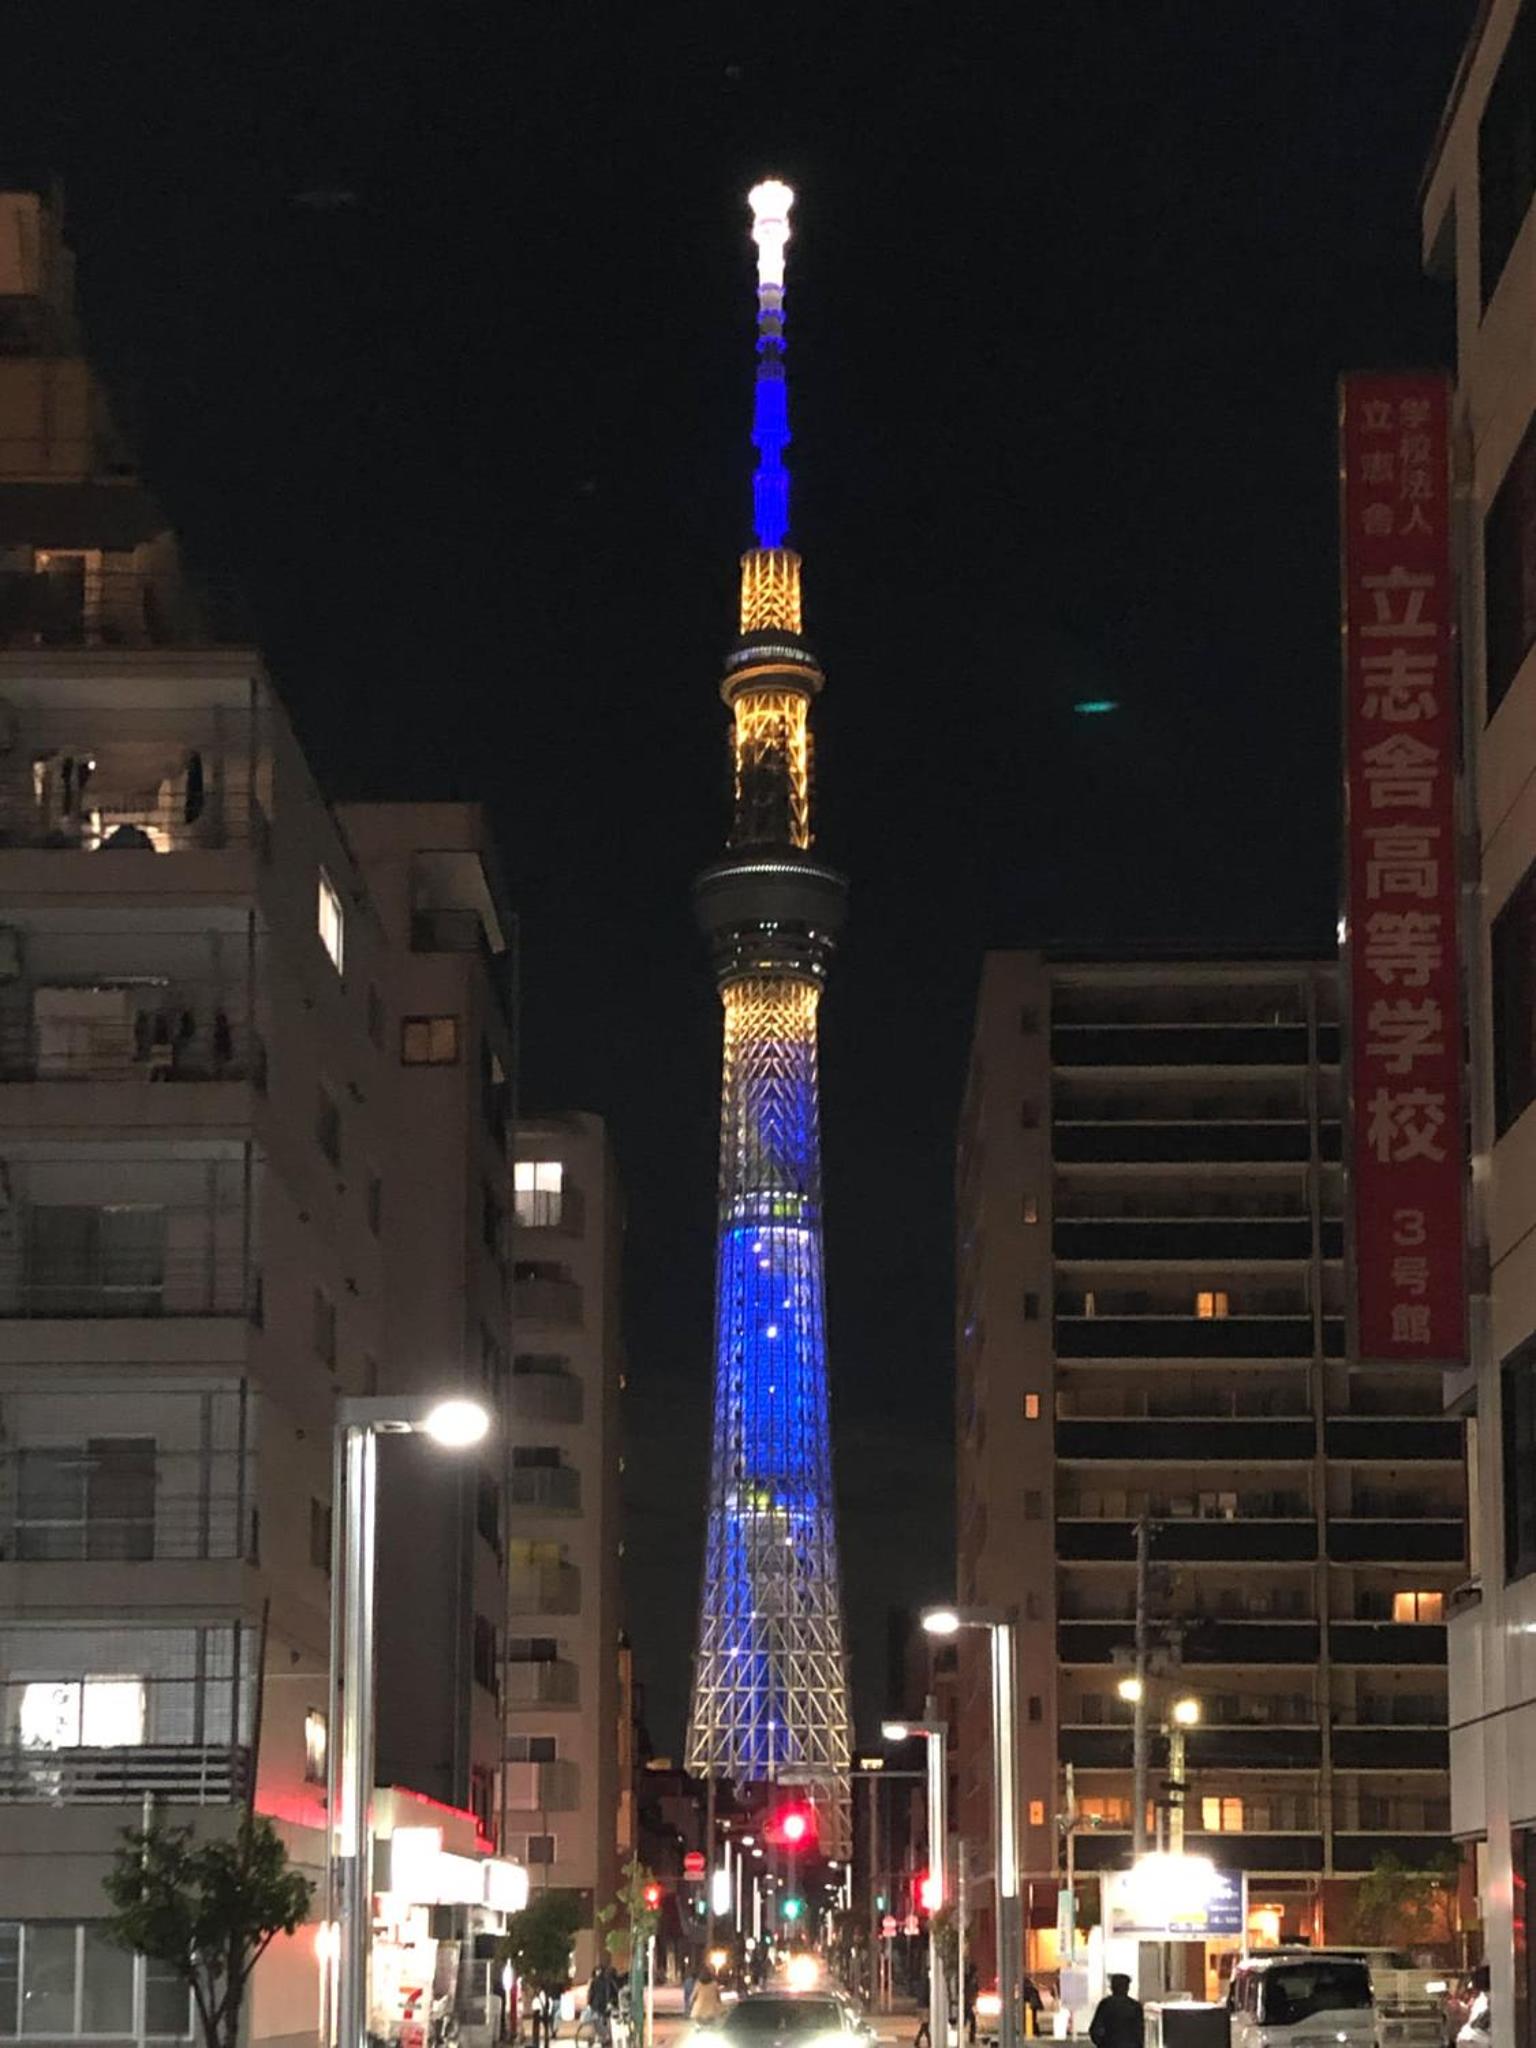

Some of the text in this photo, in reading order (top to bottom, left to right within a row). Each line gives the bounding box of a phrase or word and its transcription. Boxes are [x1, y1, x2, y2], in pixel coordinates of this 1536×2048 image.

[1360, 565, 1448, 1345] 立志舎高等学校 3号館
